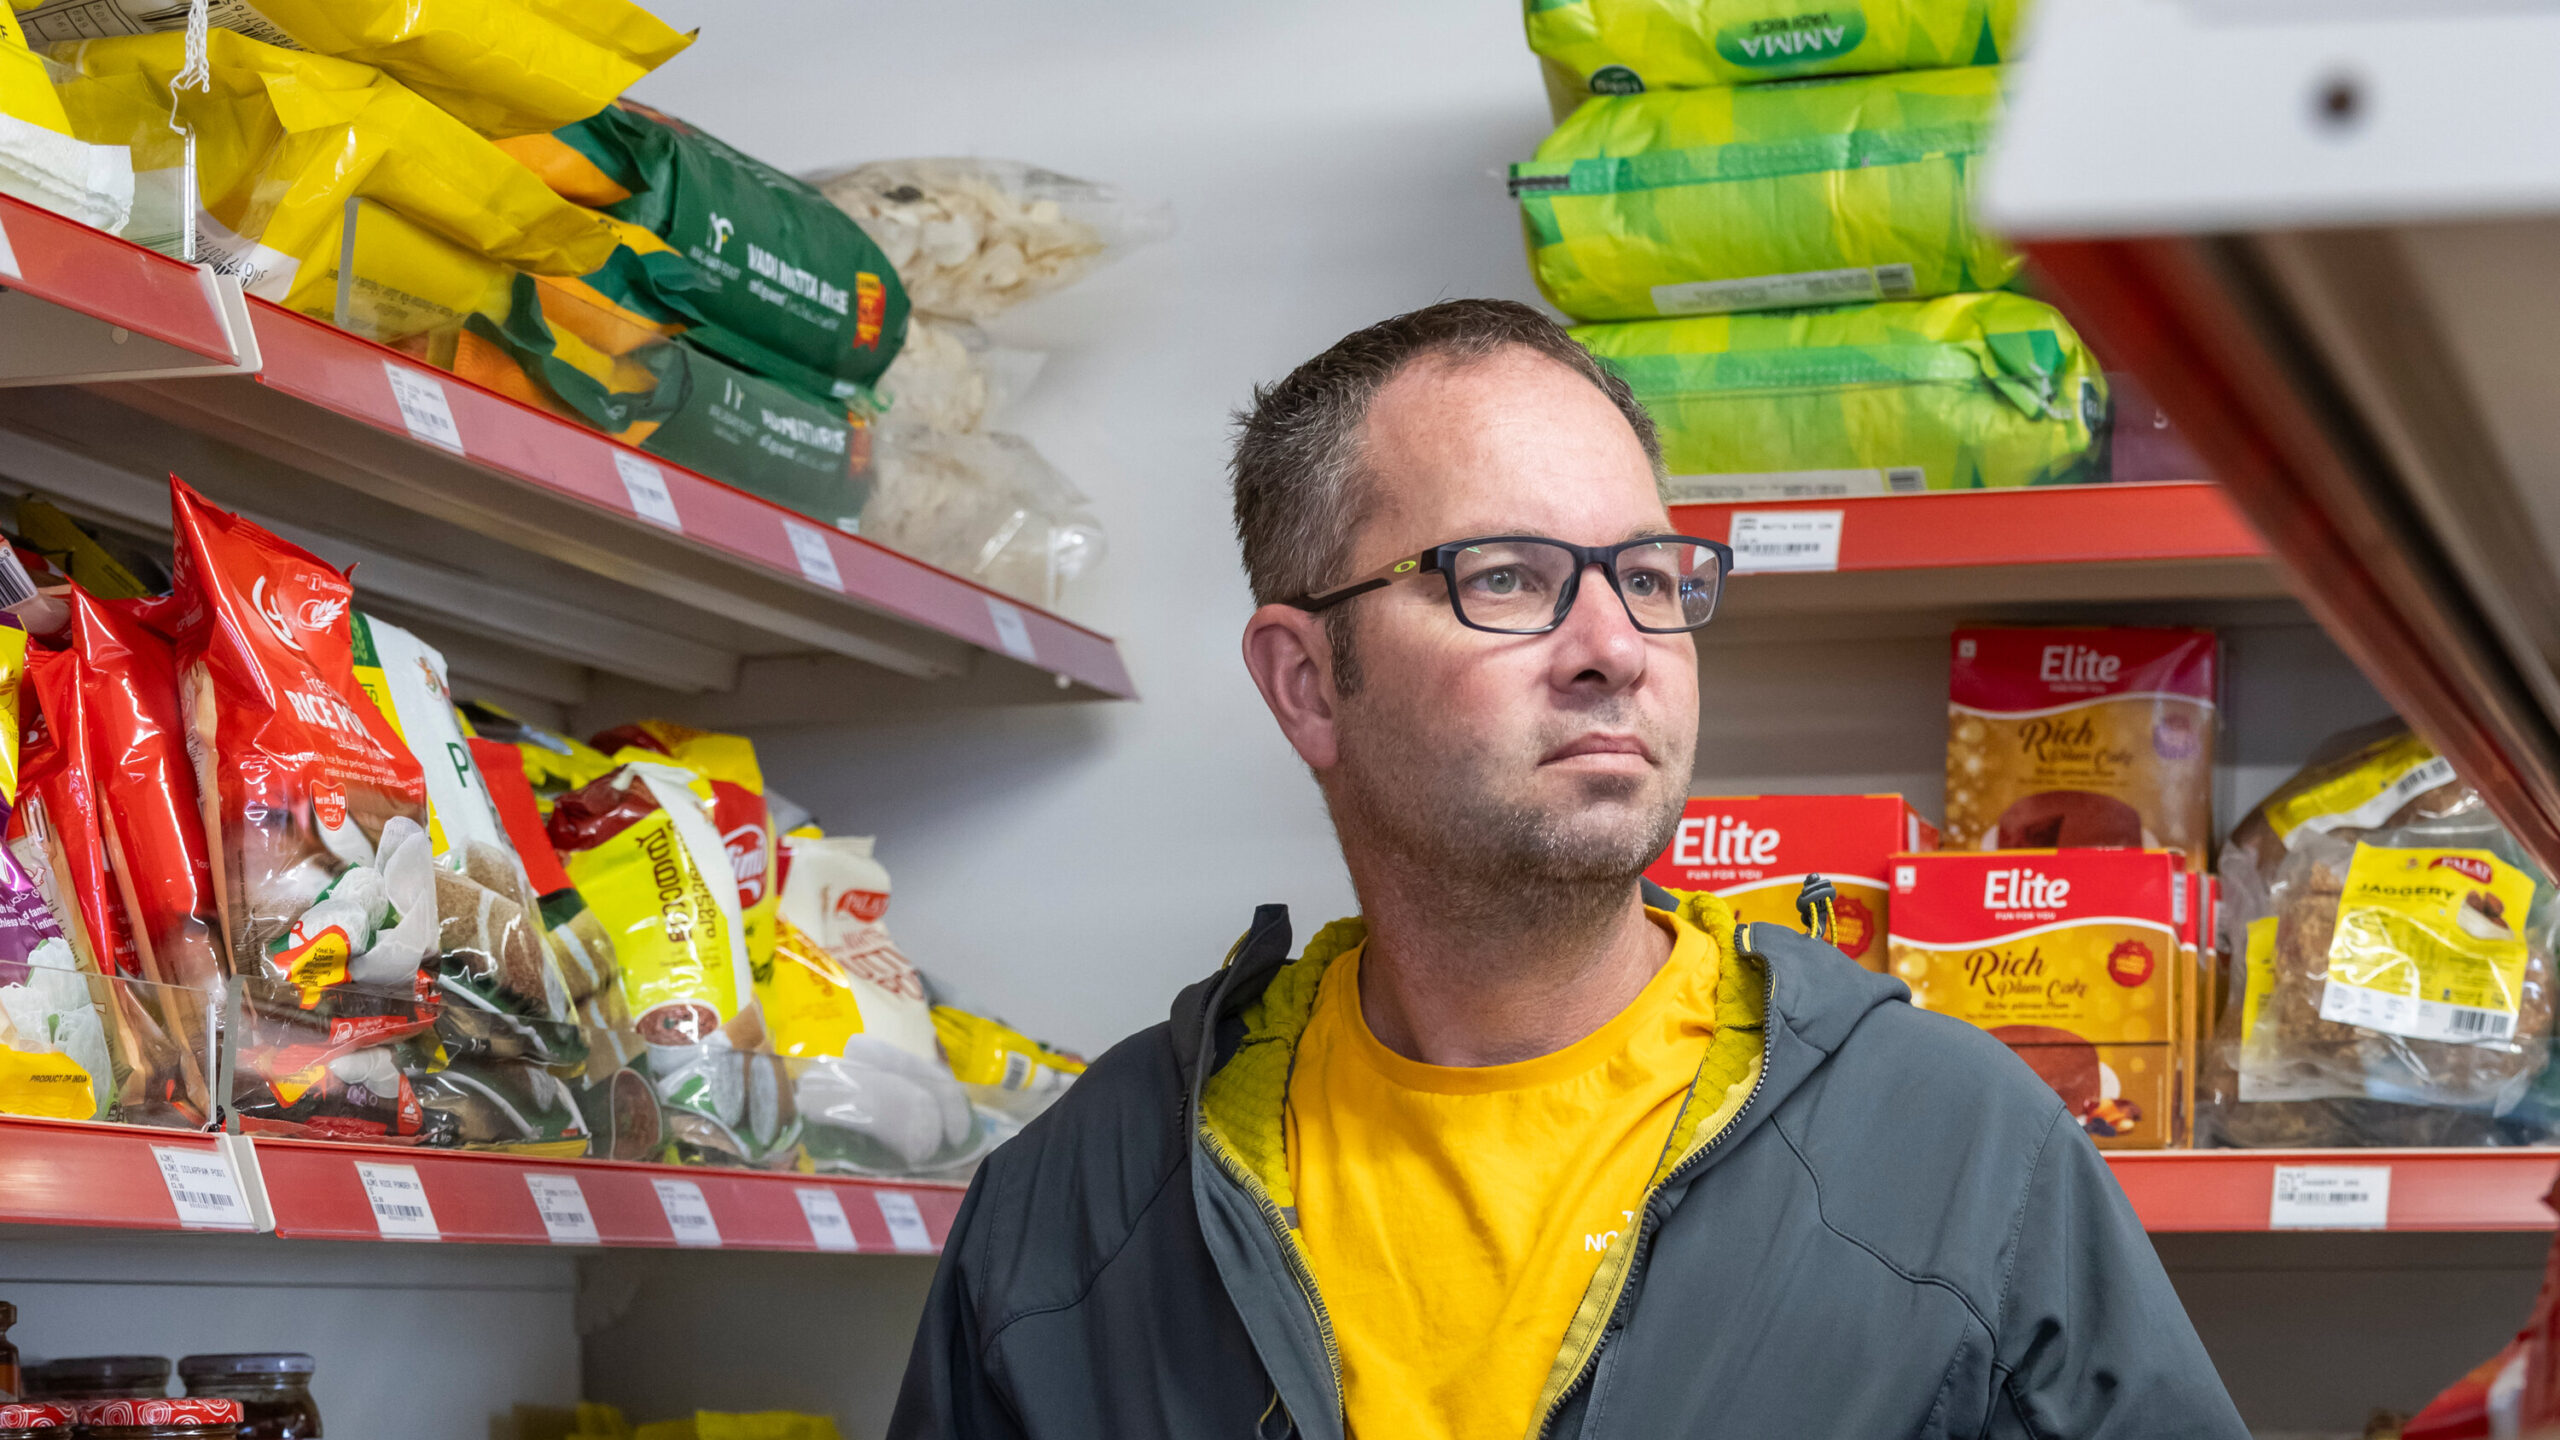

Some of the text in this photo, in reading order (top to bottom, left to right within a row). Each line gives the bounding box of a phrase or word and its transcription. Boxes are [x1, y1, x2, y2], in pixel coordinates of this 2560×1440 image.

[1738, 25, 1845, 58] AMMA
[747, 242, 779, 282] VADI
[819, 280, 849, 316] RICE
[2040, 645, 2121, 683] Elite
[285, 690, 339, 730] RICE
[2018, 718, 2096, 762] Rich
[1673, 815, 1780, 866] Elite
[1687, 870, 1763, 880] FUN FOR YOU
[1983, 868, 2070, 909] Elite
[2359, 884, 2455, 899] JAGGERY
[1995, 912, 2056, 920] FUN FOR YOU
[1965, 946, 2044, 996] Rich
[30, 1074, 88, 1083] PRODUCT OF INDIA
